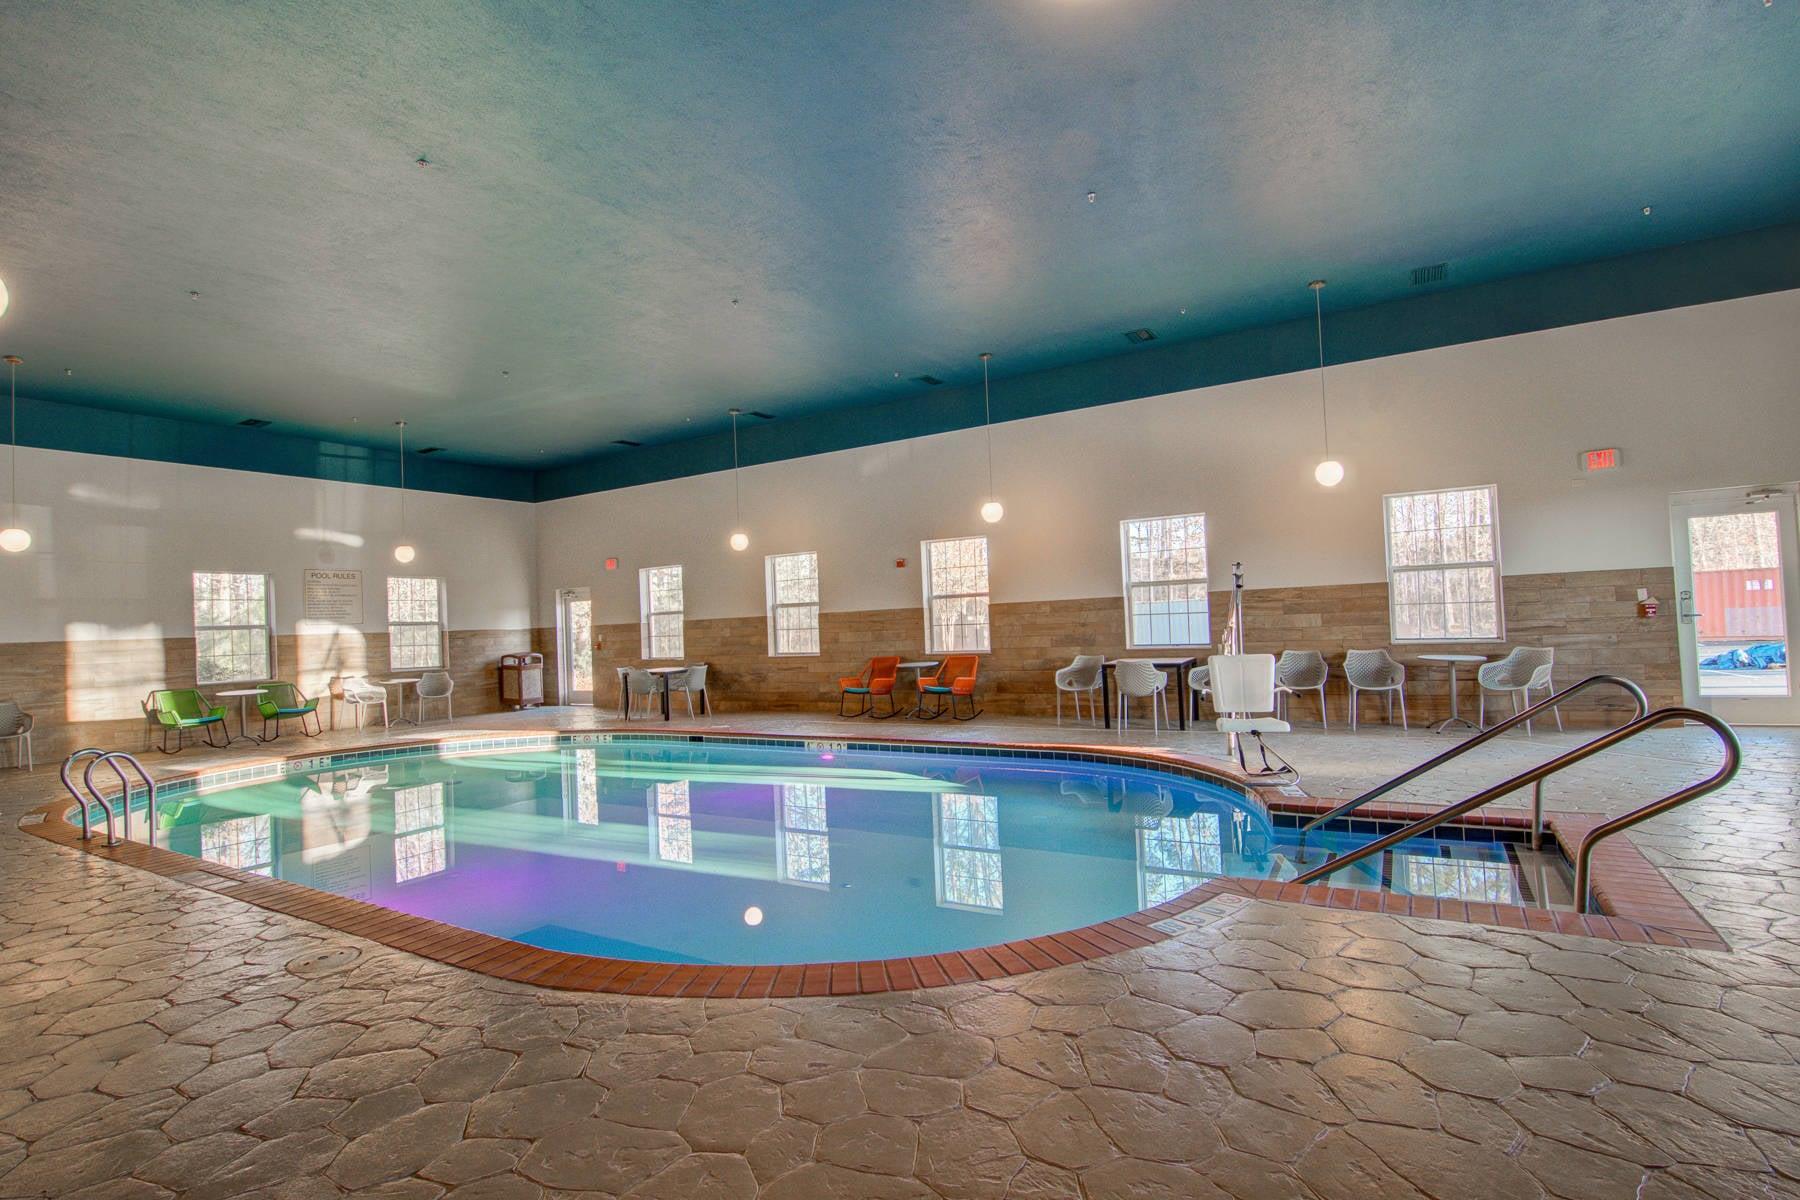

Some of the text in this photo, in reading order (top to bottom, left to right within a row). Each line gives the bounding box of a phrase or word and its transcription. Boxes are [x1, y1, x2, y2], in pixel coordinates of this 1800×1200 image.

[1586, 449, 1616, 471] EXIT
[311, 571, 357, 580] POOL RULES
